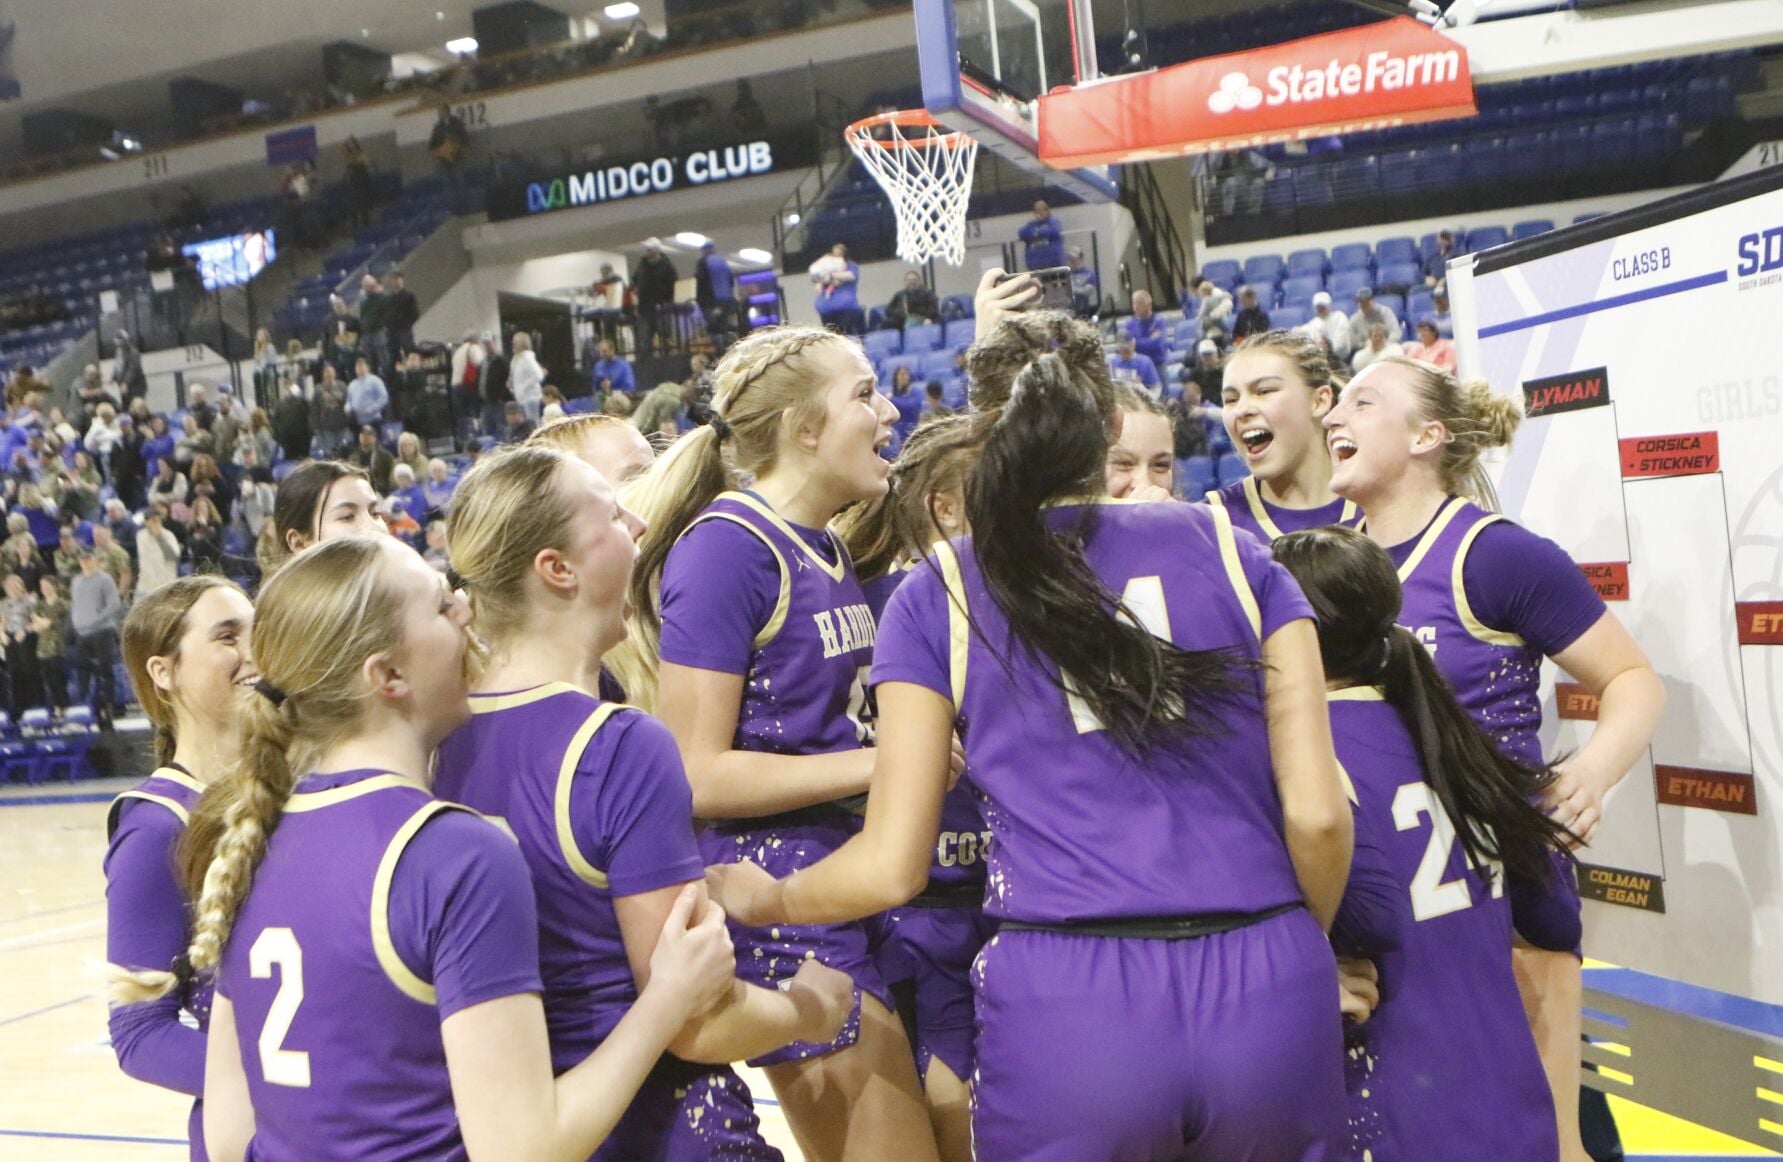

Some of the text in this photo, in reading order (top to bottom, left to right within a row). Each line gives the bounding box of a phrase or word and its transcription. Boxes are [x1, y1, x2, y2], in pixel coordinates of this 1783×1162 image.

[1758, 142, 1783, 167] 21
[568, 141, 773, 206] MIDCO CLUB
[1613, 246, 1671, 281] CLASS B
[1531, 378, 1601, 409] LYMAN
[1696, 375, 1781, 424] GIRLS
[1637, 437, 1702, 454] CORSICA
[1640, 454, 1715, 471] STICKNEY
[1751, 613, 1783, 633] ET
[1668, 777, 1746, 803] ETHAN
[1589, 870, 1651, 891] COLMAN
[1606, 888, 1648, 907] EGAN
[249, 926, 312, 1088] 2
